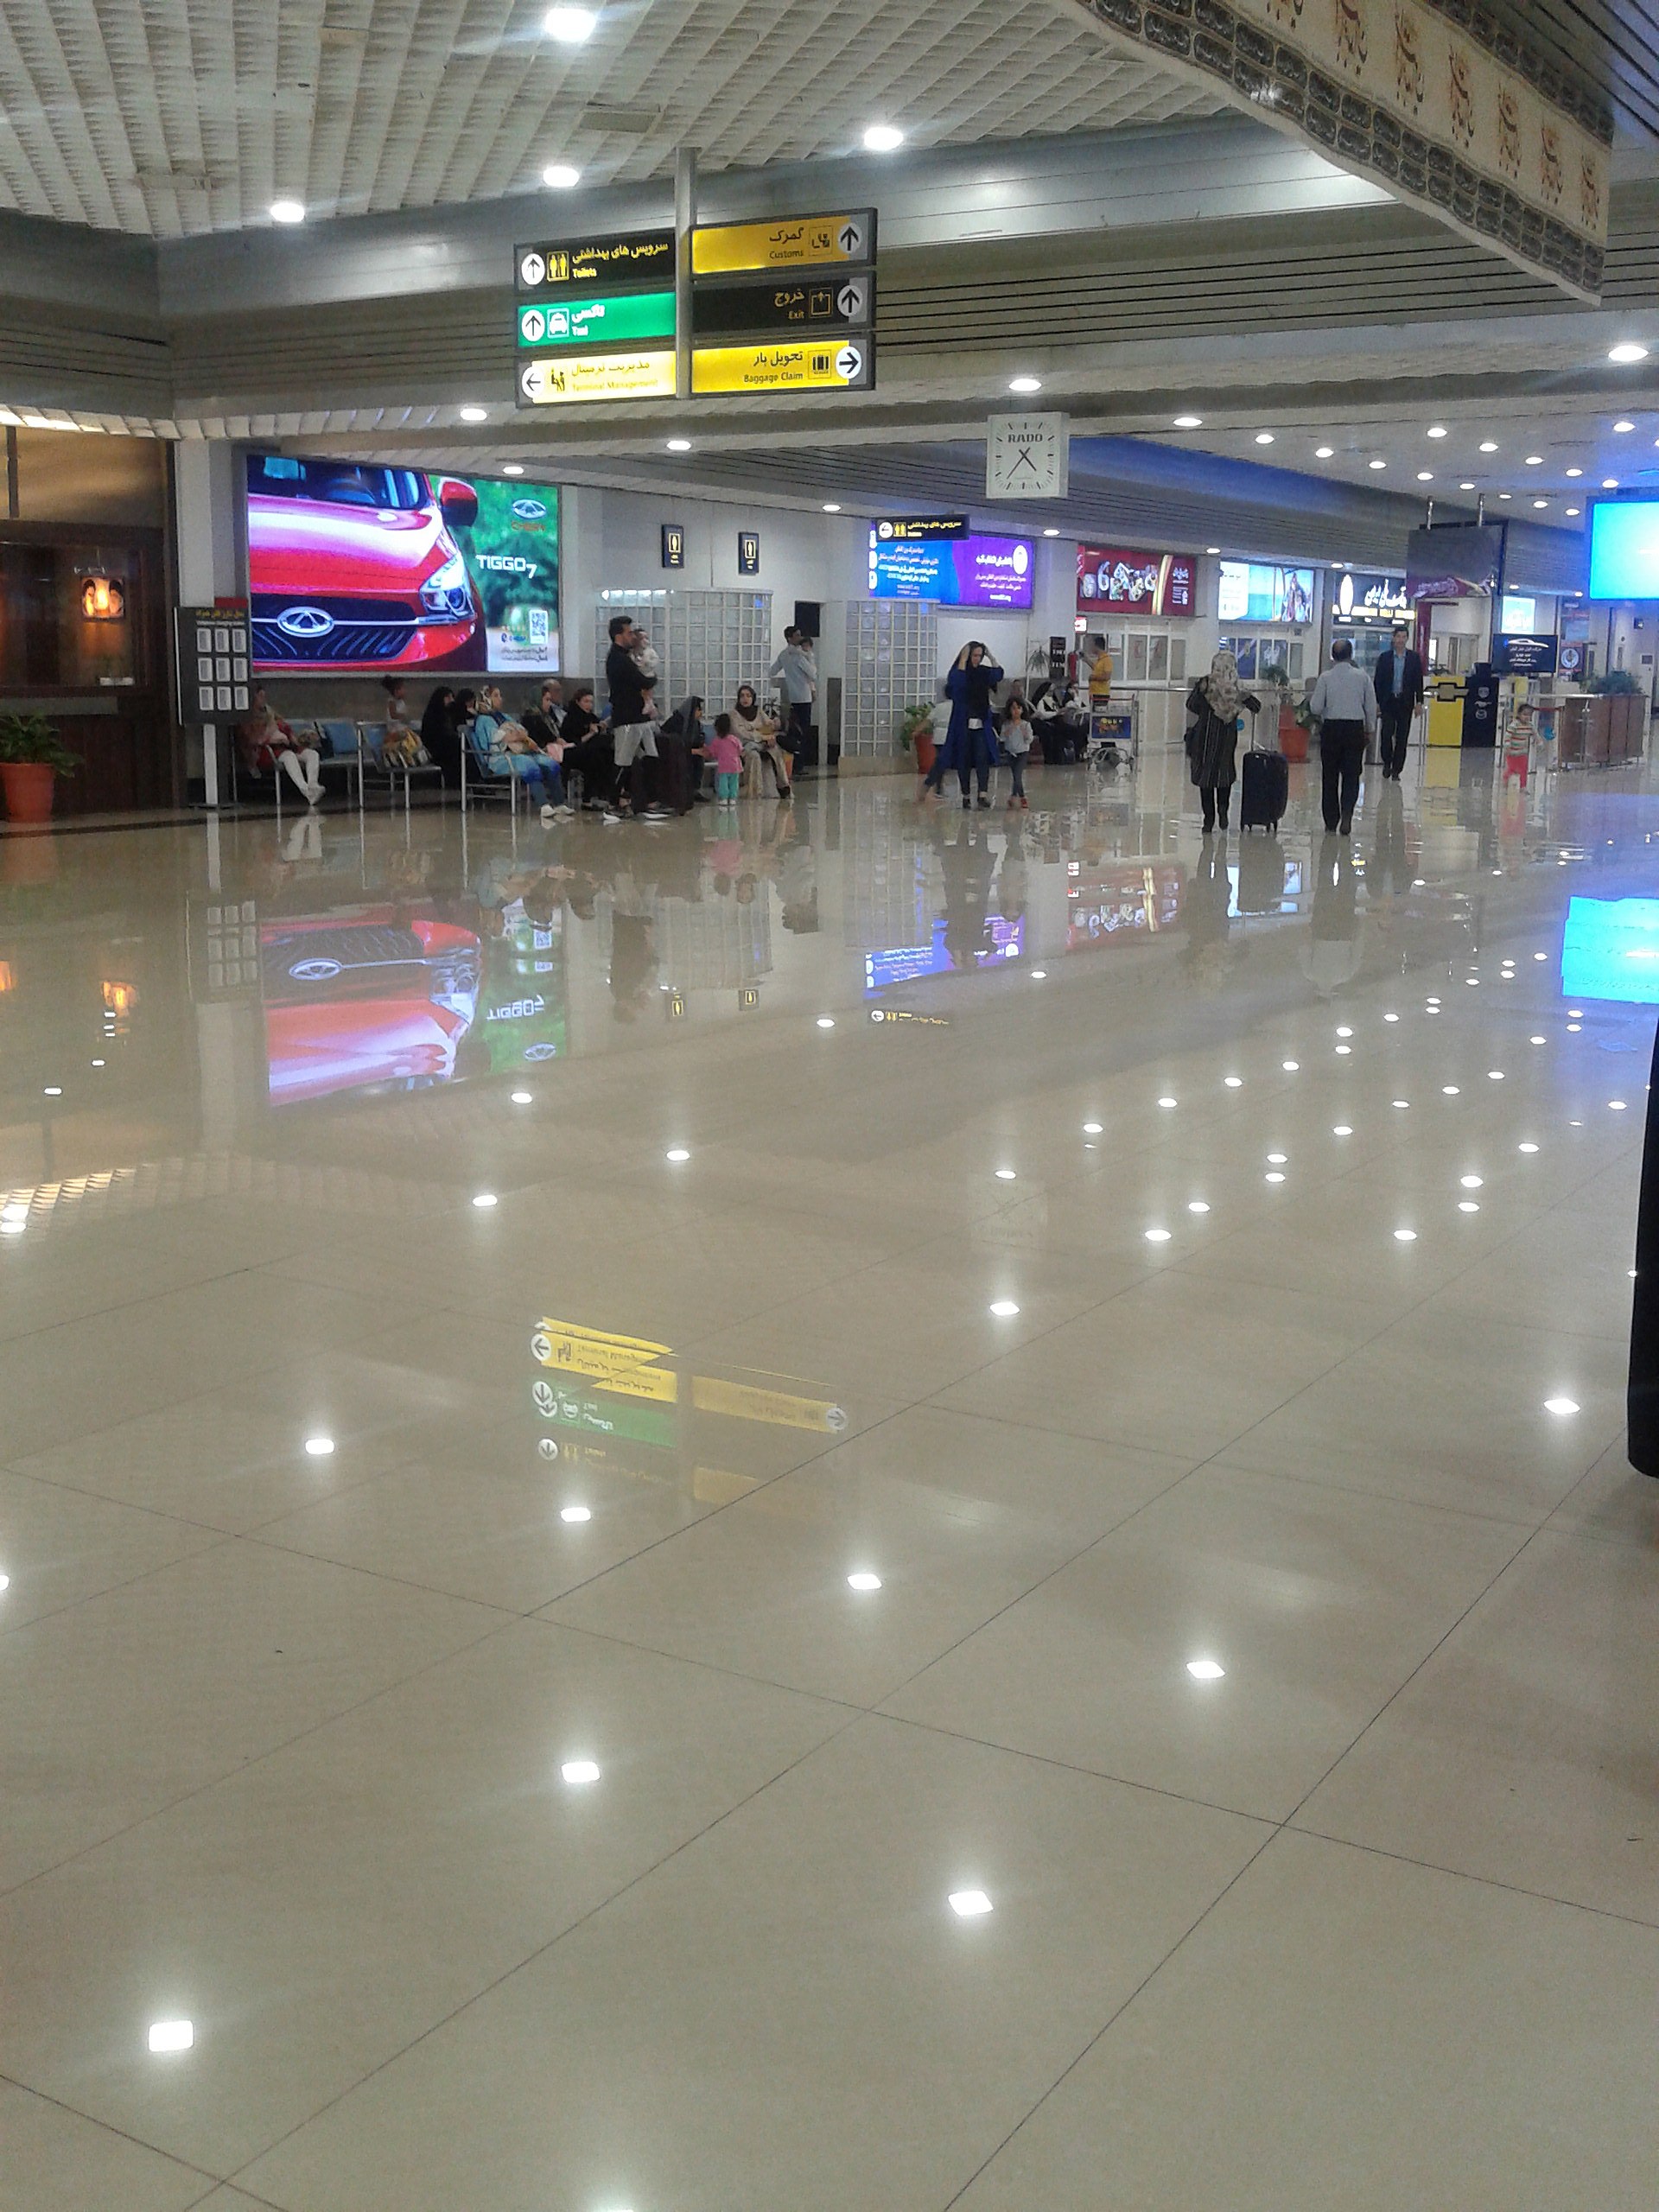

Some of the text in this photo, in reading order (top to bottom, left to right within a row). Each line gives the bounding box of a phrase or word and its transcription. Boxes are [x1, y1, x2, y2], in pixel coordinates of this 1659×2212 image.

[769, 226, 804, 245] گمرک
[572, 244, 669, 264] سرویس های بهداشتی
[769, 250, 804, 259] Customs
[774, 288, 805, 308] خروج
[788, 310, 804, 320] Exit
[753, 351, 804, 367] تحویل بار
[744, 372, 804, 385] Baggage Claim
[1007, 434, 1043, 443] RADO
